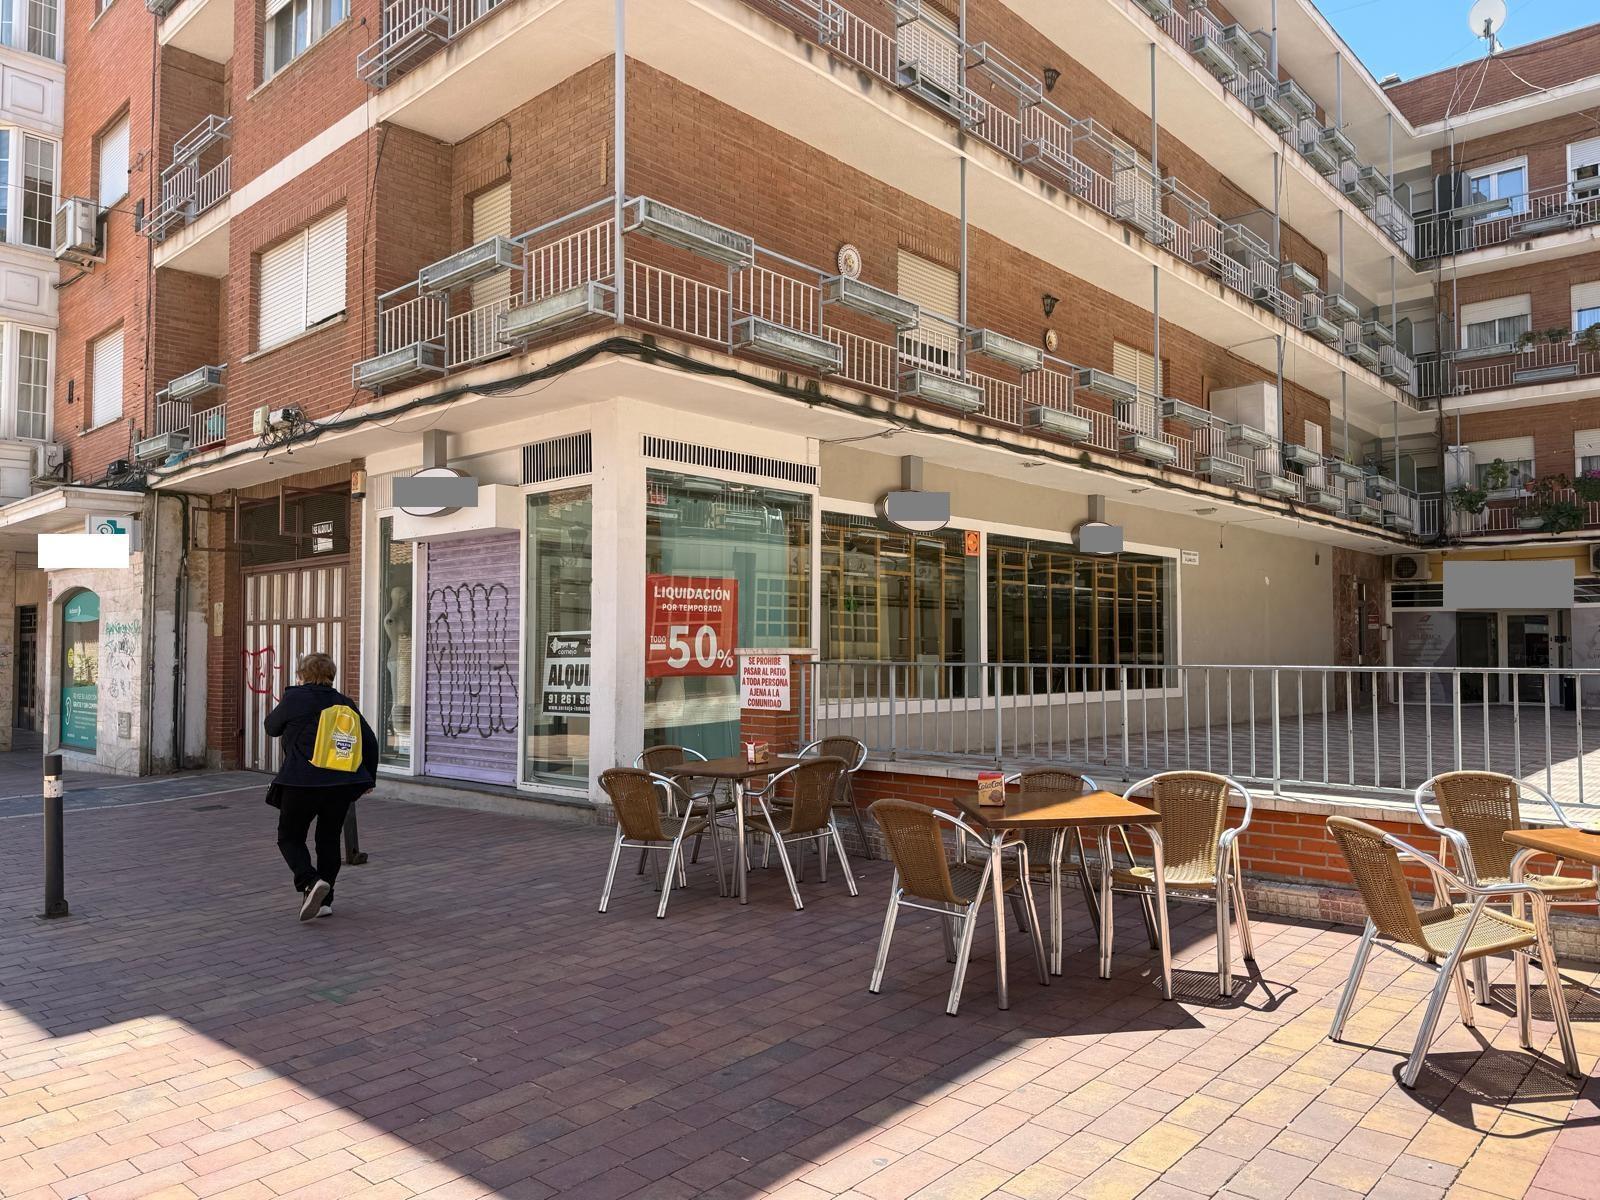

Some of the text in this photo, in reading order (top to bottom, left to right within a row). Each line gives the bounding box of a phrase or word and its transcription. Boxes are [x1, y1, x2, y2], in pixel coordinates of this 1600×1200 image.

[654, 586, 730, 600] LIQUIDACIÓN
[662, 603, 723, 612] POR TEMPORADA
[650, 635, 666, 643] TODO
[748, 657, 781, 665] SE PROHIBE
[744, 667, 786, 676] PASAR AL PATIO
[548, 664, 591, 689] ALQUI
[742, 677, 788, 687] A TODA PERSONA
[750, 688, 779, 697] AJENA A LA
[548, 694, 558, 704] 91
[561, 694, 576, 704] 261
[747, 698, 782, 708] COMUNIDAD
